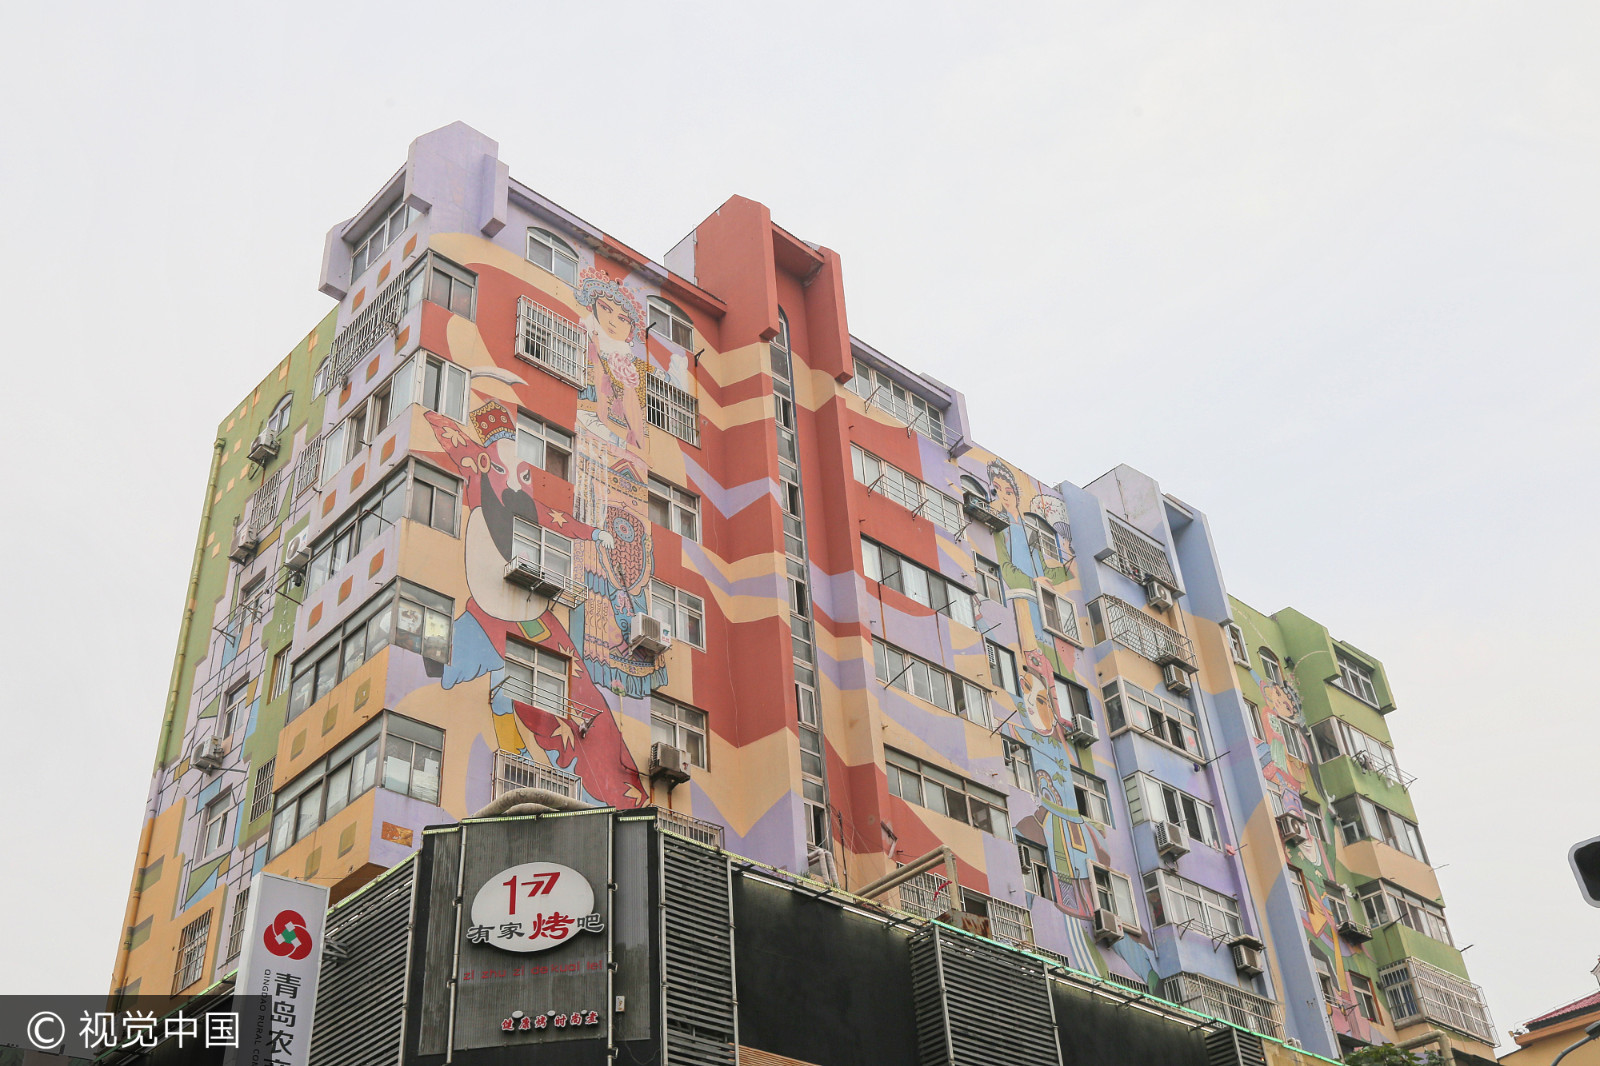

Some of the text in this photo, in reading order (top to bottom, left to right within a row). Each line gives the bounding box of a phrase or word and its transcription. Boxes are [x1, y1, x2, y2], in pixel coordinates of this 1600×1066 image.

[466, 911, 605, 944] 有家烤吧
[259, 968, 272, 1012] QINGDAO
[481, 968, 507, 979] zhu
[254, 1014, 266, 1045] RURAL
[264, 972, 302, 1066] 青岛农
